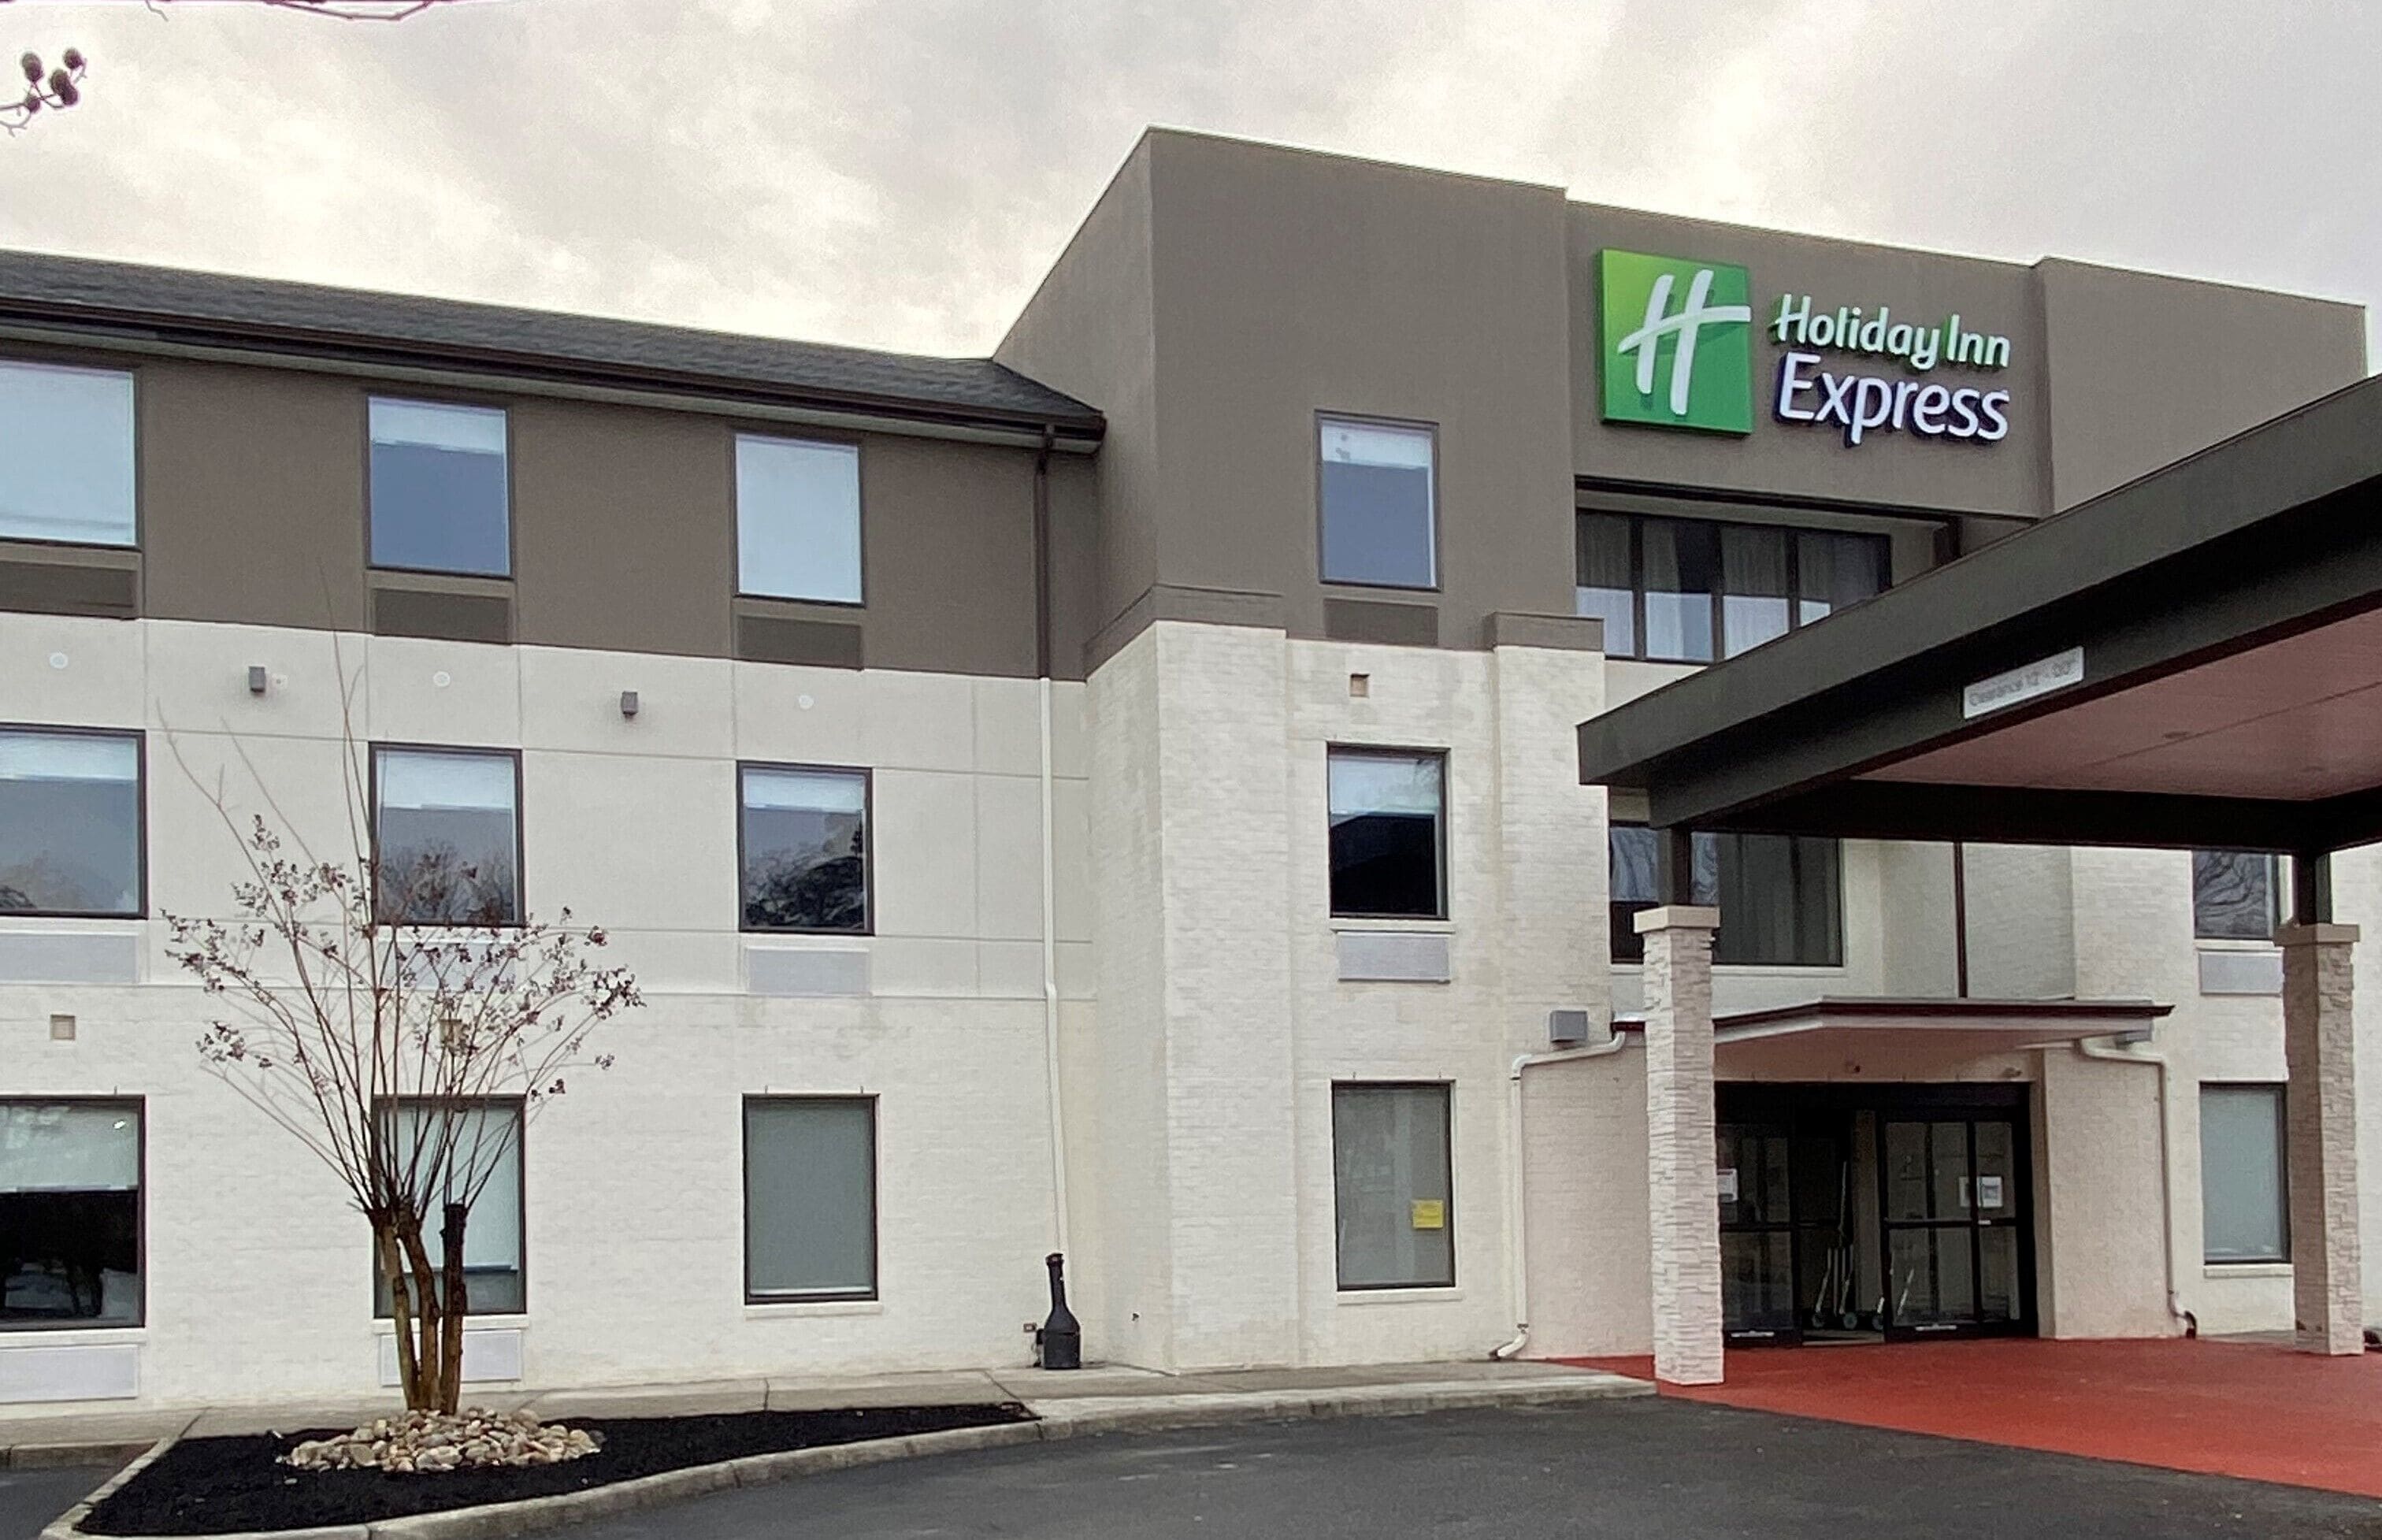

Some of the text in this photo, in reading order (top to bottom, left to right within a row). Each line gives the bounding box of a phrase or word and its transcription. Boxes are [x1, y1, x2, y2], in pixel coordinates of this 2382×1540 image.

[1772, 293, 2010, 371] Holiday Inn
[1777, 351, 2010, 446] Express
